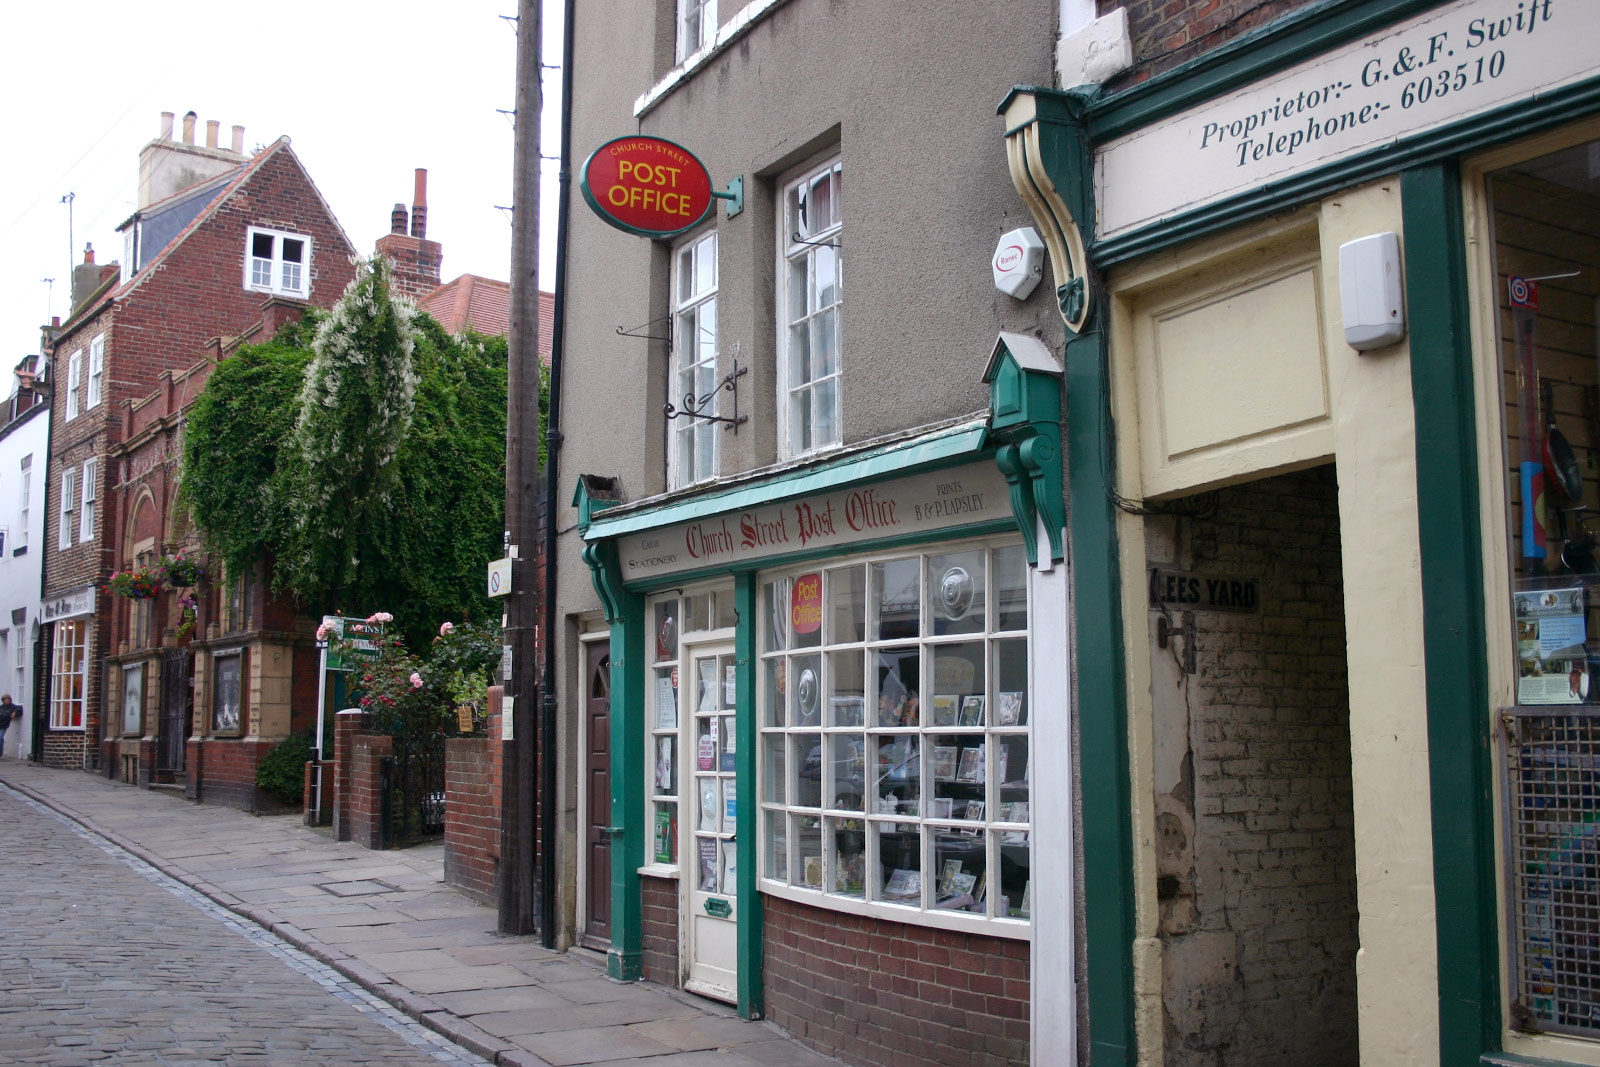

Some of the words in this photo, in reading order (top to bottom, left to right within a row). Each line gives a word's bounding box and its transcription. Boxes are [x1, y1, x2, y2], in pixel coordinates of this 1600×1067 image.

[1465, 0, 1554, 50] Swift
[1400, 49, 1506, 111] 603510
[610, 142, 653, 156] CHURCH
[656, 145, 690, 167] STREET
[619, 160, 681, 188] POST
[608, 184, 691, 217] OFFICE
[936, 481, 963, 496] PRINTS
[686, 519, 734, 560] Church
[740, 508, 789, 550] Street
[795, 498, 836, 548] Post
[845, 489, 901, 532] Office.
[914, 504, 922, 520] B
[924, 503, 933, 520] &
[798, 579, 818, 602] Post
[1206, 578, 1256, 608] YARD
[792, 604, 822, 625] Office
